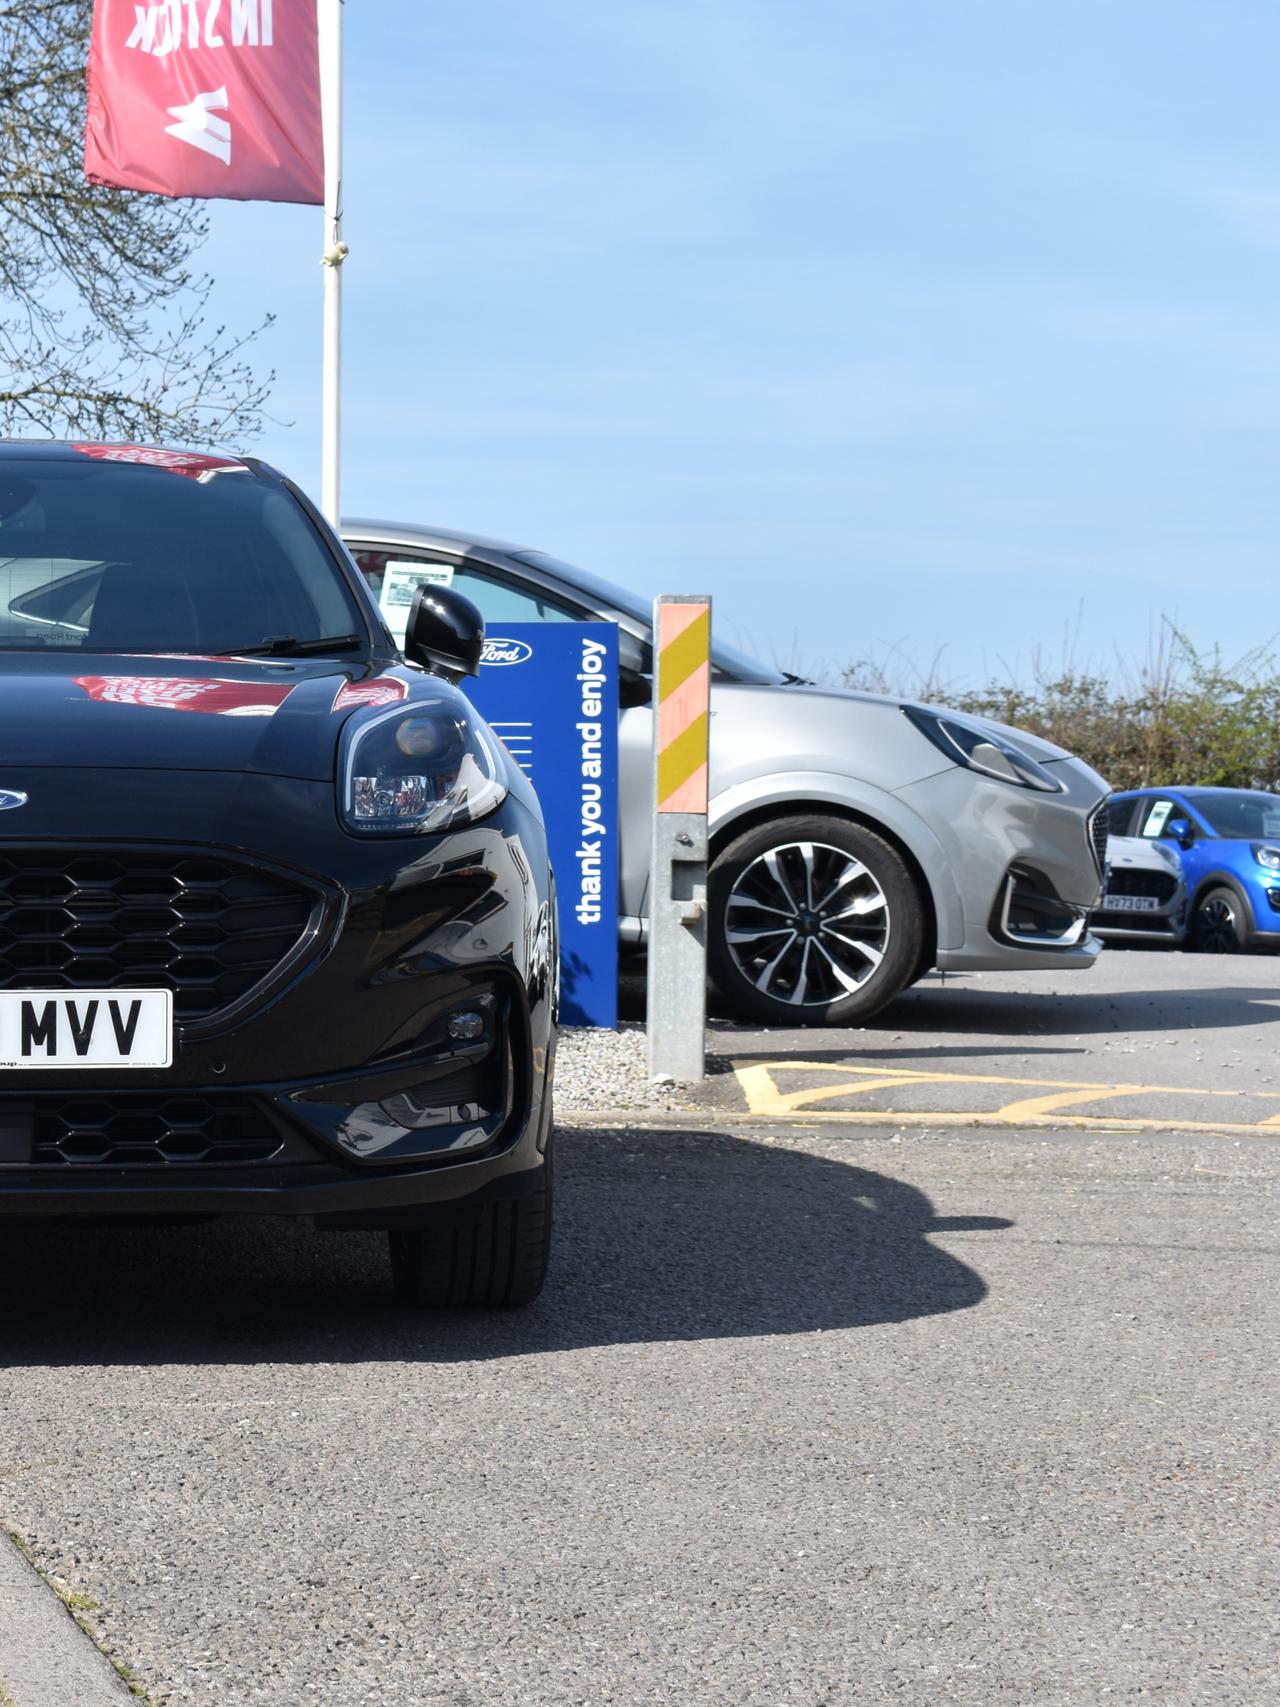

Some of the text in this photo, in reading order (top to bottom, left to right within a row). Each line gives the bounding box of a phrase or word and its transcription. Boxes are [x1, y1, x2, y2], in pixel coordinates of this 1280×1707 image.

[480, 642, 519, 661] Ford
[575, 638, 607, 925] thank you and enjoy
[21, 1000, 142, 1056] MVV
